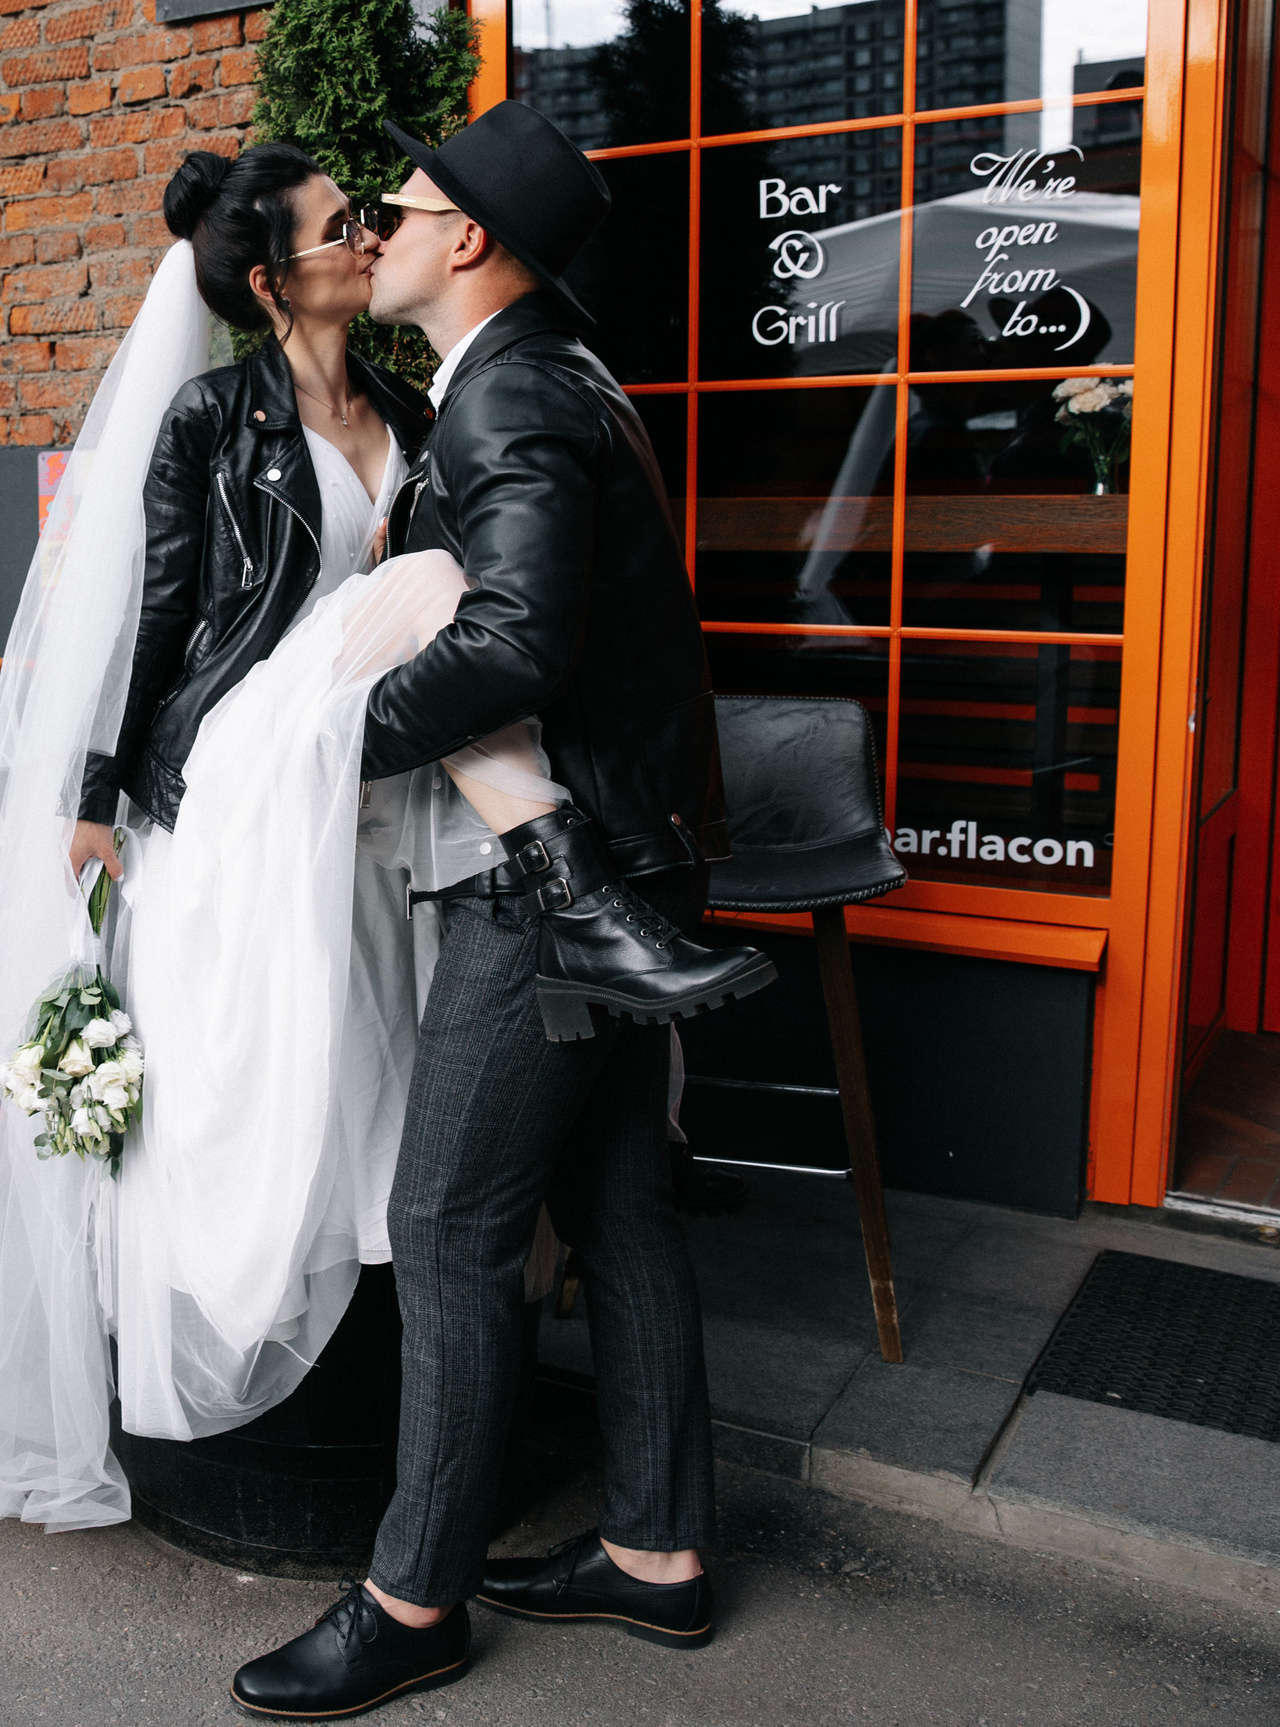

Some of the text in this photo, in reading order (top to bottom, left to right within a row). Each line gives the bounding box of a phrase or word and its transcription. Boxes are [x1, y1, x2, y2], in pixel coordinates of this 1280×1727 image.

[970, 144, 1084, 204] We're
[759, 178, 842, 219] Bar
[768, 229, 825, 280] &
[975, 221, 1059, 262] open
[960, 253, 1061, 309] from
[751, 300, 847, 346] Grill
[884, 820, 1095, 868] ar.flacon
